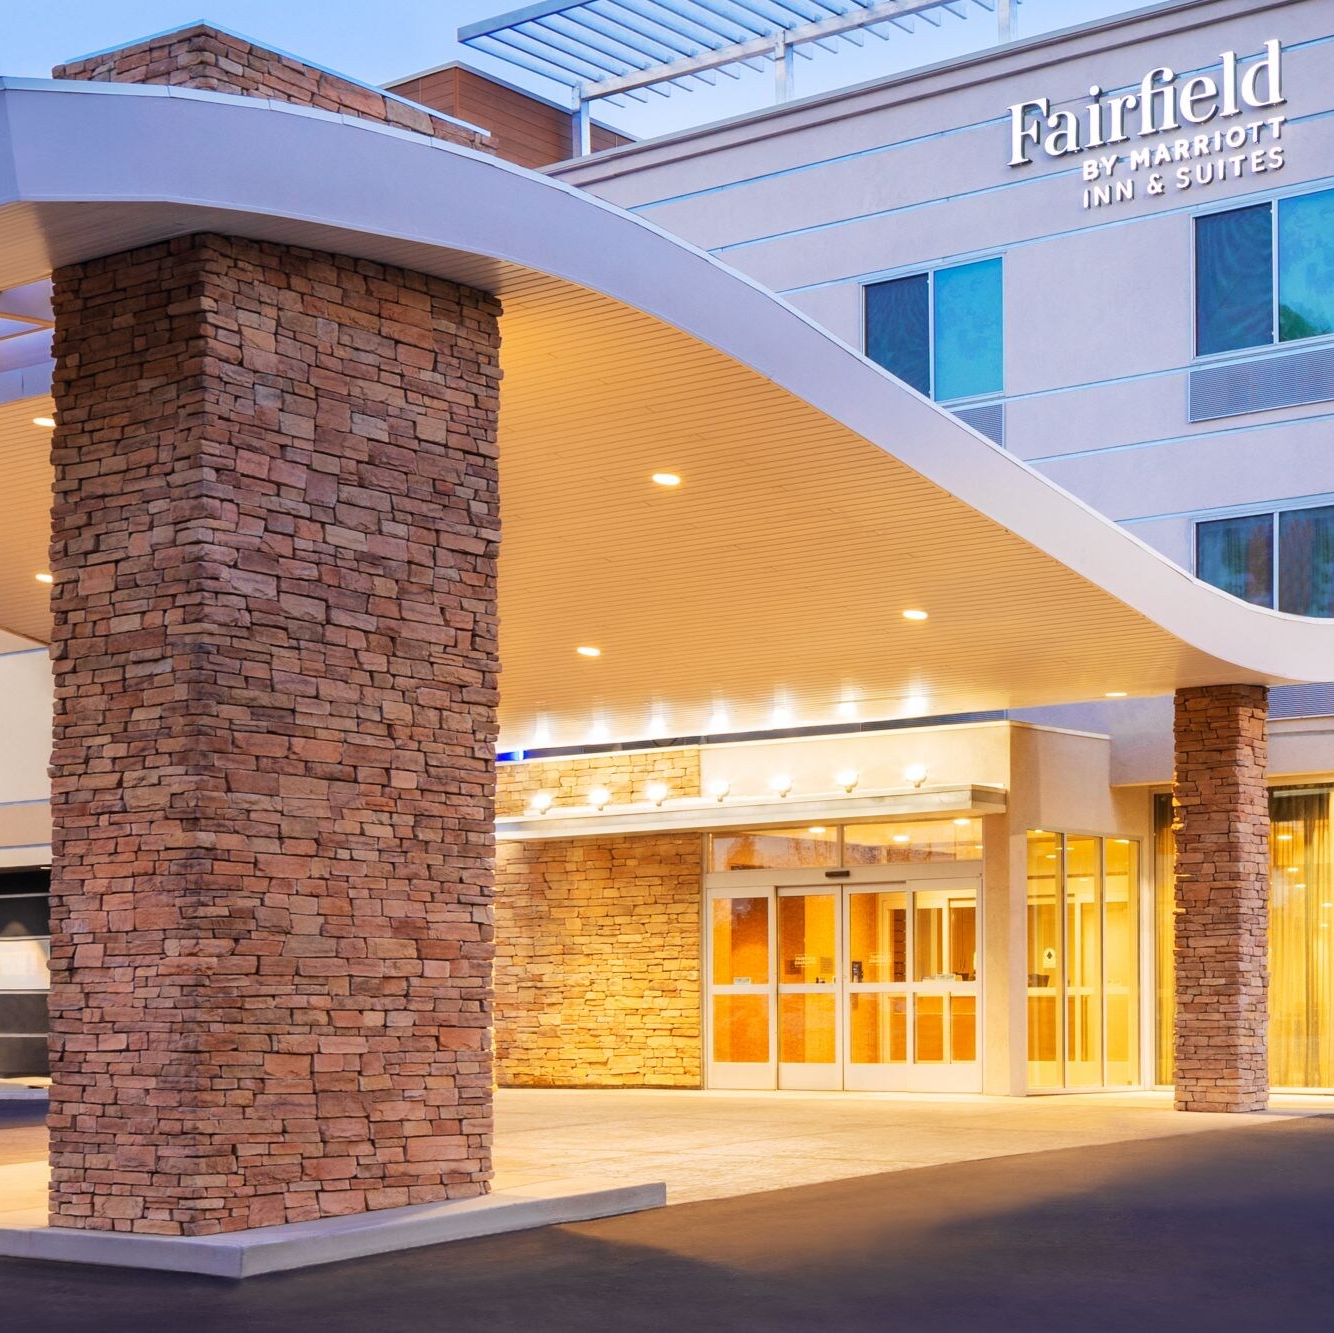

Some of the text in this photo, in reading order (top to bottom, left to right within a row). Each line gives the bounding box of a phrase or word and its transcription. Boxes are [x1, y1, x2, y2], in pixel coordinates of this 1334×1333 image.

[1007, 39, 1287, 166] Fairfield
[1083, 116, 1286, 180] BY MARRIOTT
[1083, 147, 1285, 208] INN & SUITES
